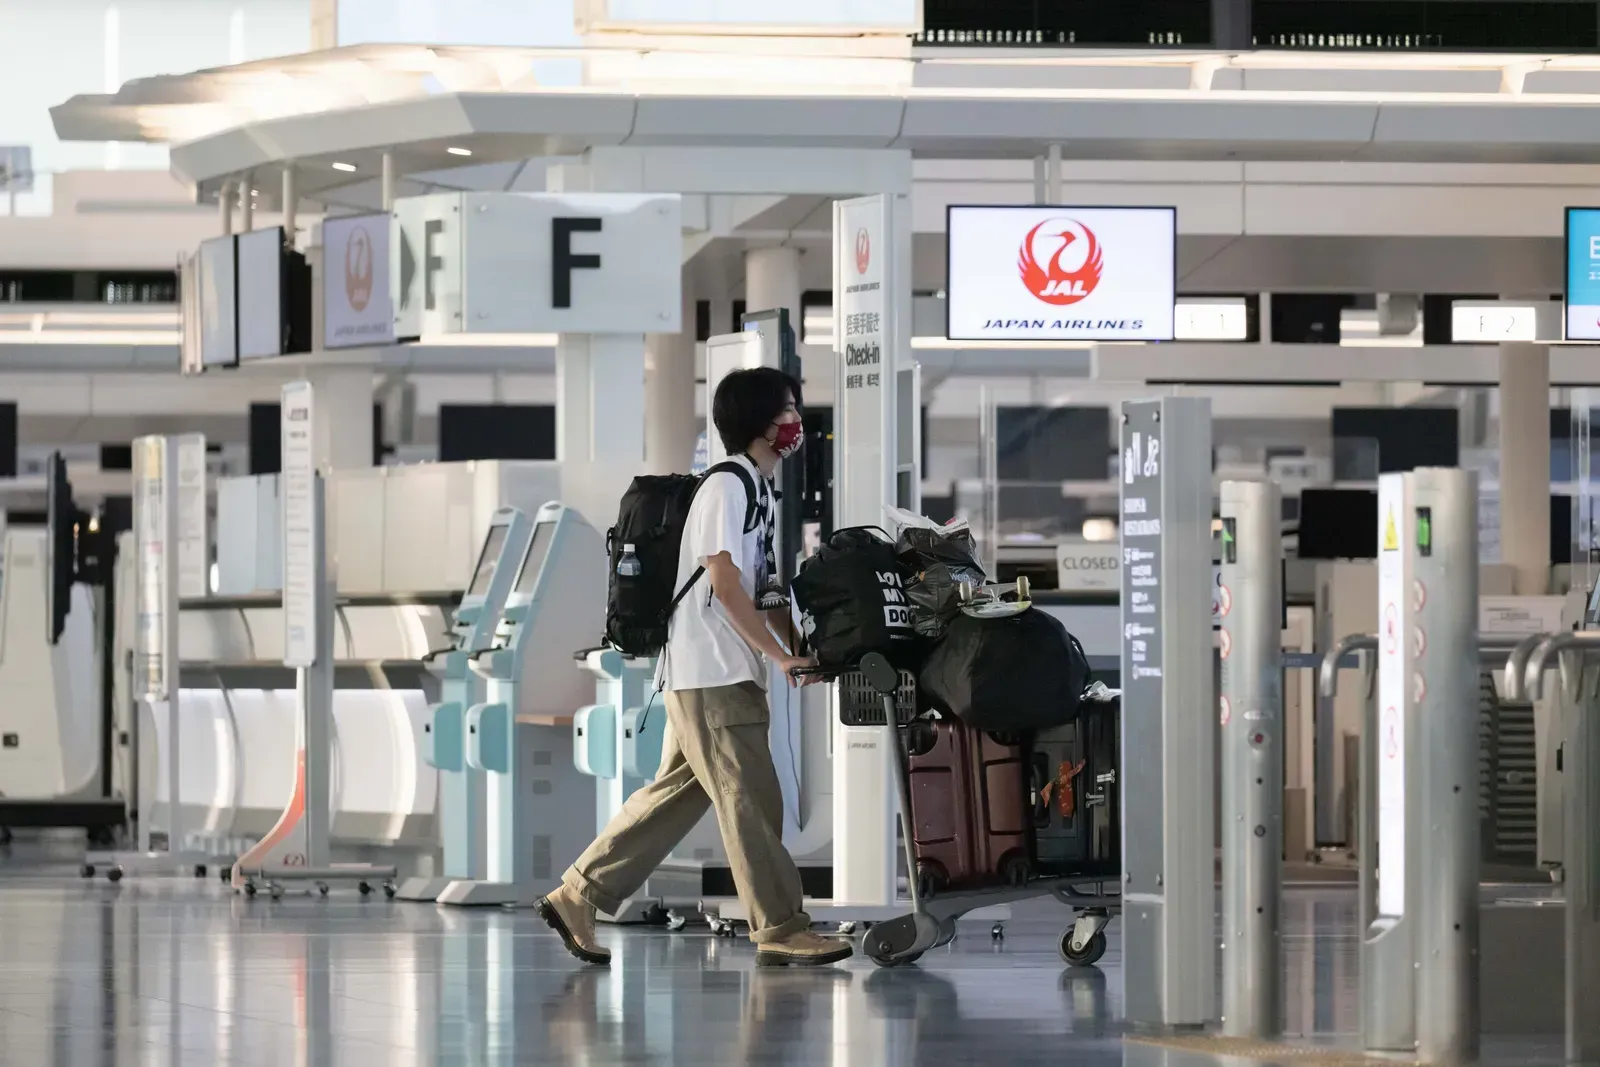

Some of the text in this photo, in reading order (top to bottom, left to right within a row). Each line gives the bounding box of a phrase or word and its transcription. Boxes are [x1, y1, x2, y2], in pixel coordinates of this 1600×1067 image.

[425, 219, 442, 311] F
[551, 217, 602, 309] F
[1039, 280, 1088, 297] JAL
[982, 319, 1144, 330] JAPAN AIRLINES
[1505, 315, 1516, 333] 2
[846, 341, 880, 367] Check-in
[1063, 556, 1119, 570] CLOSED
